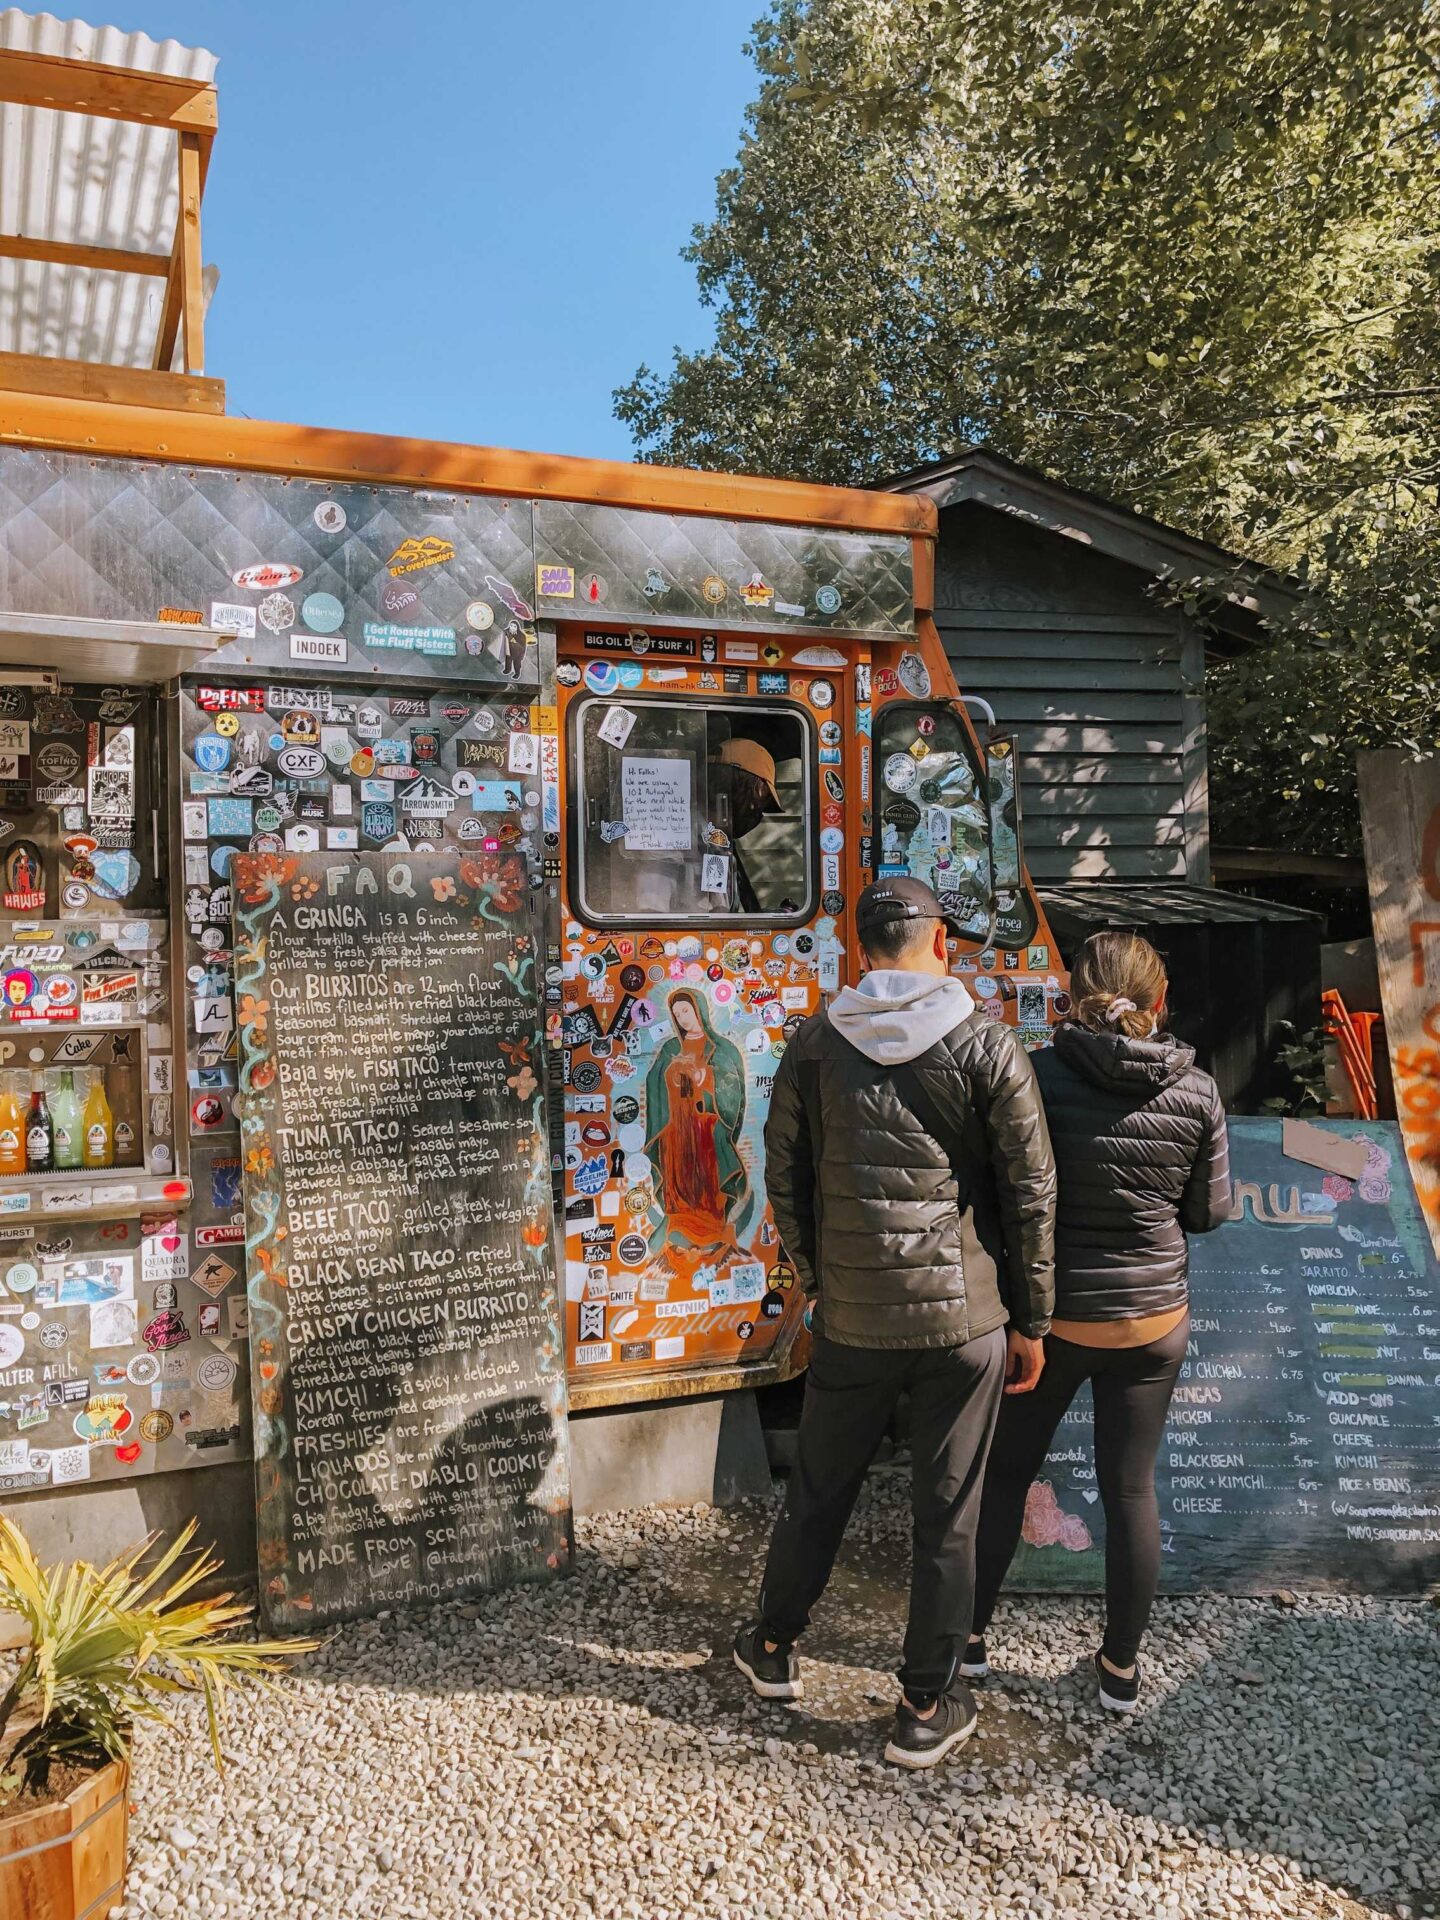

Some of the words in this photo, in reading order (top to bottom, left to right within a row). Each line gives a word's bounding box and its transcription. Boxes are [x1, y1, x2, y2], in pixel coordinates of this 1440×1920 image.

[390, 565, 405, 577] BC
[407, 551, 456, 572] overlanders
[542, 569, 571, 581] SAUL
[542, 581, 571, 594] GOOD
[365, 625, 368, 634] I
[370, 626, 387, 635] Got
[392, 626, 430, 637] Roasted
[432, 629, 454, 639] With
[296, 640, 340, 656] INDOEK
[365, 636, 385, 646] The
[388, 636, 413, 648] Fluff
[416, 638, 454, 649] Sisters
[587, 636, 603, 645] BIG
[606, 637, 622, 646] OIL
[658, 641, 682, 650] SURF
[40, 757, 78, 766] TOFINO
[286, 754, 317, 767] CXF
[402, 800, 453, 810] ARROWSMITH
[90, 816, 135, 828] MEAT
[409, 820, 438, 829] NECK
[90, 827, 135, 838] Cheese
[406, 828, 442, 838] WOODS
[827, 858, 837, 886] SUGA
[4, 893, 45, 908] HAWGS
[294, 905, 367, 930] GRINGA
[268, 932, 307, 947] flour
[313, 932, 354, 945] tortilla
[362, 930, 406, 944] stuffed
[439, 928, 479, 942] cheese
[291, 946, 327, 958] beans
[84, 955, 134, 969] FULCRUM
[269, 958, 307, 975] grilled
[334, 959, 375, 972] gooey
[84, 988, 102, 1002] FIVE
[104, 975, 136, 994] FATHOMS
[305, 974, 388, 999] BURRITOS
[15, 1009, 31, 1018] FEED
[33, 1009, 45, 1017] THE
[47, 1007, 75, 1017] HIPPIES
[272, 998, 331, 1016] tortillas
[336, 998, 373, 1012] filled
[408, 996, 453, 1010] refried
[275, 1015, 337, 1031] seasoned
[457, 1009, 505, 1026] cabbage
[352, 1028, 402, 1047] chipotle
[64, 1038, 93, 1056] Cake
[407, 1040, 448, 1055] veggie
[280, 1064, 317, 1084] Baja
[363, 1058, 399, 1078] FISH
[449, 1057, 505, 1075] tempura
[281, 1082, 342, 1100] battered
[423, 1074, 468, 1092] chipotle
[427, 1085, 476, 1101] cabbage
[368, 1102, 419, 1117] tortilla
[276, 1128, 330, 1149] TUNA
[281, 1148, 342, 1164] albacore
[410, 1138, 456, 1151] wasabi
[284, 1163, 347, 1178] shredded
[456, 1148, 499, 1164] fresca
[285, 1176, 341, 1192] seaweed
[574, 1170, 609, 1186] BASELINE
[332, 1189, 364, 1203] flour
[288, 1207, 338, 1233] BEEF
[292, 1230, 352, 1250] sriracha
[582, 1226, 615, 1242] refined
[149, 1238, 156, 1255] I
[321, 1242, 377, 1258] cilantro
[1300, 1247, 1344, 1260] DRINKS
[144, 1255, 186, 1266] QUADRA
[288, 1260, 352, 1289] BLACK
[355, 1252, 405, 1279] BEAN
[465, 1242, 512, 1263] refried
[485, 1258, 525, 1276] fresca
[144, 1267, 186, 1279] ISLAND
[519, 1268, 556, 1283] tortilla
[1300, 1266, 1349, 1278] JARRITO
[386, 1287, 442, 1306] cilantro
[658, 1301, 706, 1315] BEATNIK
[286, 1312, 359, 1344] CRISPY
[363, 1299, 449, 1334] CHICKEN
[454, 1292, 535, 1321] BURRITO:
[1190, 1319, 1220, 1332] BEAN
[379, 1334, 413, 1349] black
[418, 1338, 472, 1357] seasoned
[292, 1369, 355, 1390] shredded
[360, 1361, 414, 1380] cabbage
[464, 1360, 519, 1382] delicious
[1196, 1362, 1242, 1378] CHICKEN
[1386, 1375, 1426, 1386] BANANA
[294, 1384, 367, 1415] KIMCHI
[350, 1400, 418, 1424] fermented
[494, 1401, 549, 1423] slushies
[1329, 1412, 1390, 1427] GUACAMOLE
[1167, 1432, 1200, 1446] PORK
[1333, 1434, 1374, 1447] CHEESE
[296, 1450, 390, 1483] LIQUADOS
[488, 1450, 549, 1477] COOKIE
[1335, 1455, 1378, 1468] KIMCHI
[1171, 1476, 1206, 1489] PORK
[1218, 1476, 1265, 1489] KIMCHI
[1338, 1477, 1363, 1491] RICE
[1374, 1478, 1411, 1494] BEANS
[373, 1498, 413, 1514] cookie
[1173, 1498, 1222, 1513] CHEESE
[329, 1518, 386, 1536] chocolate
[297, 1542, 355, 1575] MADE
[364, 1536, 416, 1561] FROM
[425, 1519, 502, 1546] SCRATCH
[368, 1554, 412, 1579] LOVE
